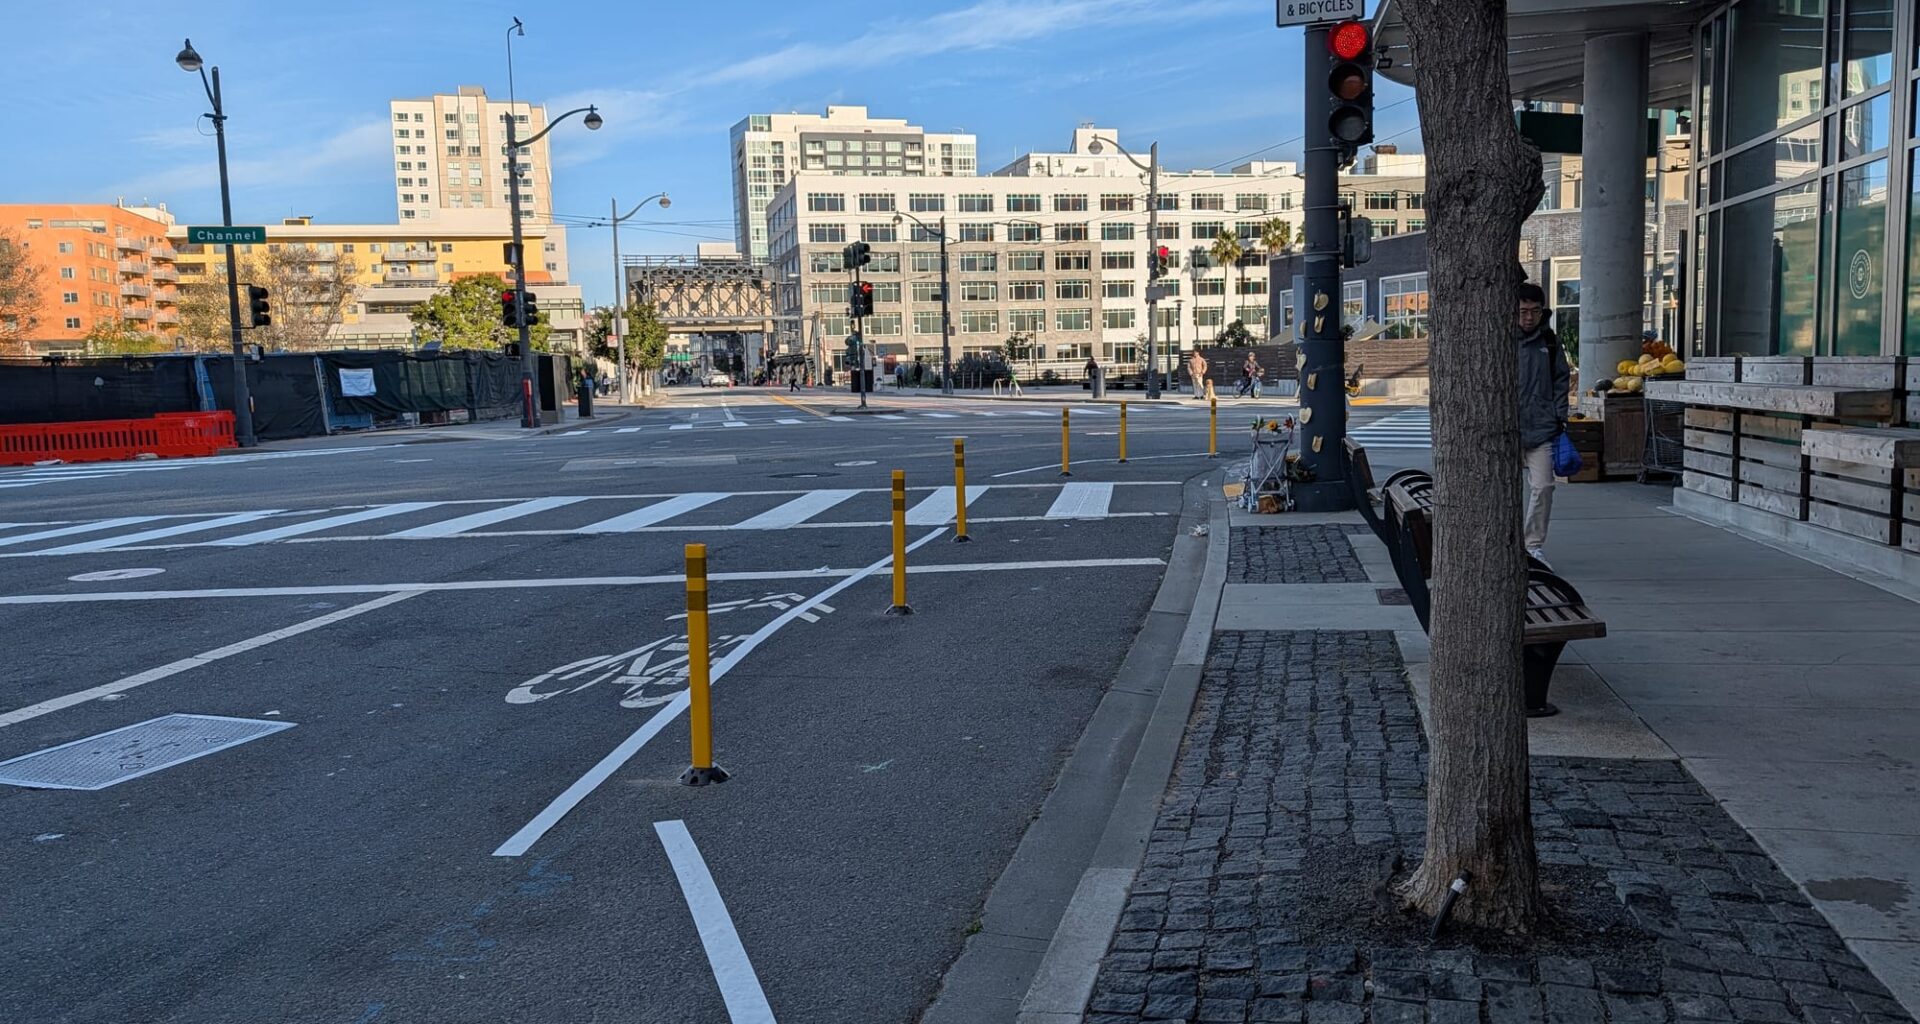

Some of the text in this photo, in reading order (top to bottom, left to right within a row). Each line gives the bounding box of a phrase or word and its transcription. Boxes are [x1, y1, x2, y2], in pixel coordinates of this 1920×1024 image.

[1287, 0, 1354, 17] & BICYCLES
[197, 231, 257, 241] Channel
